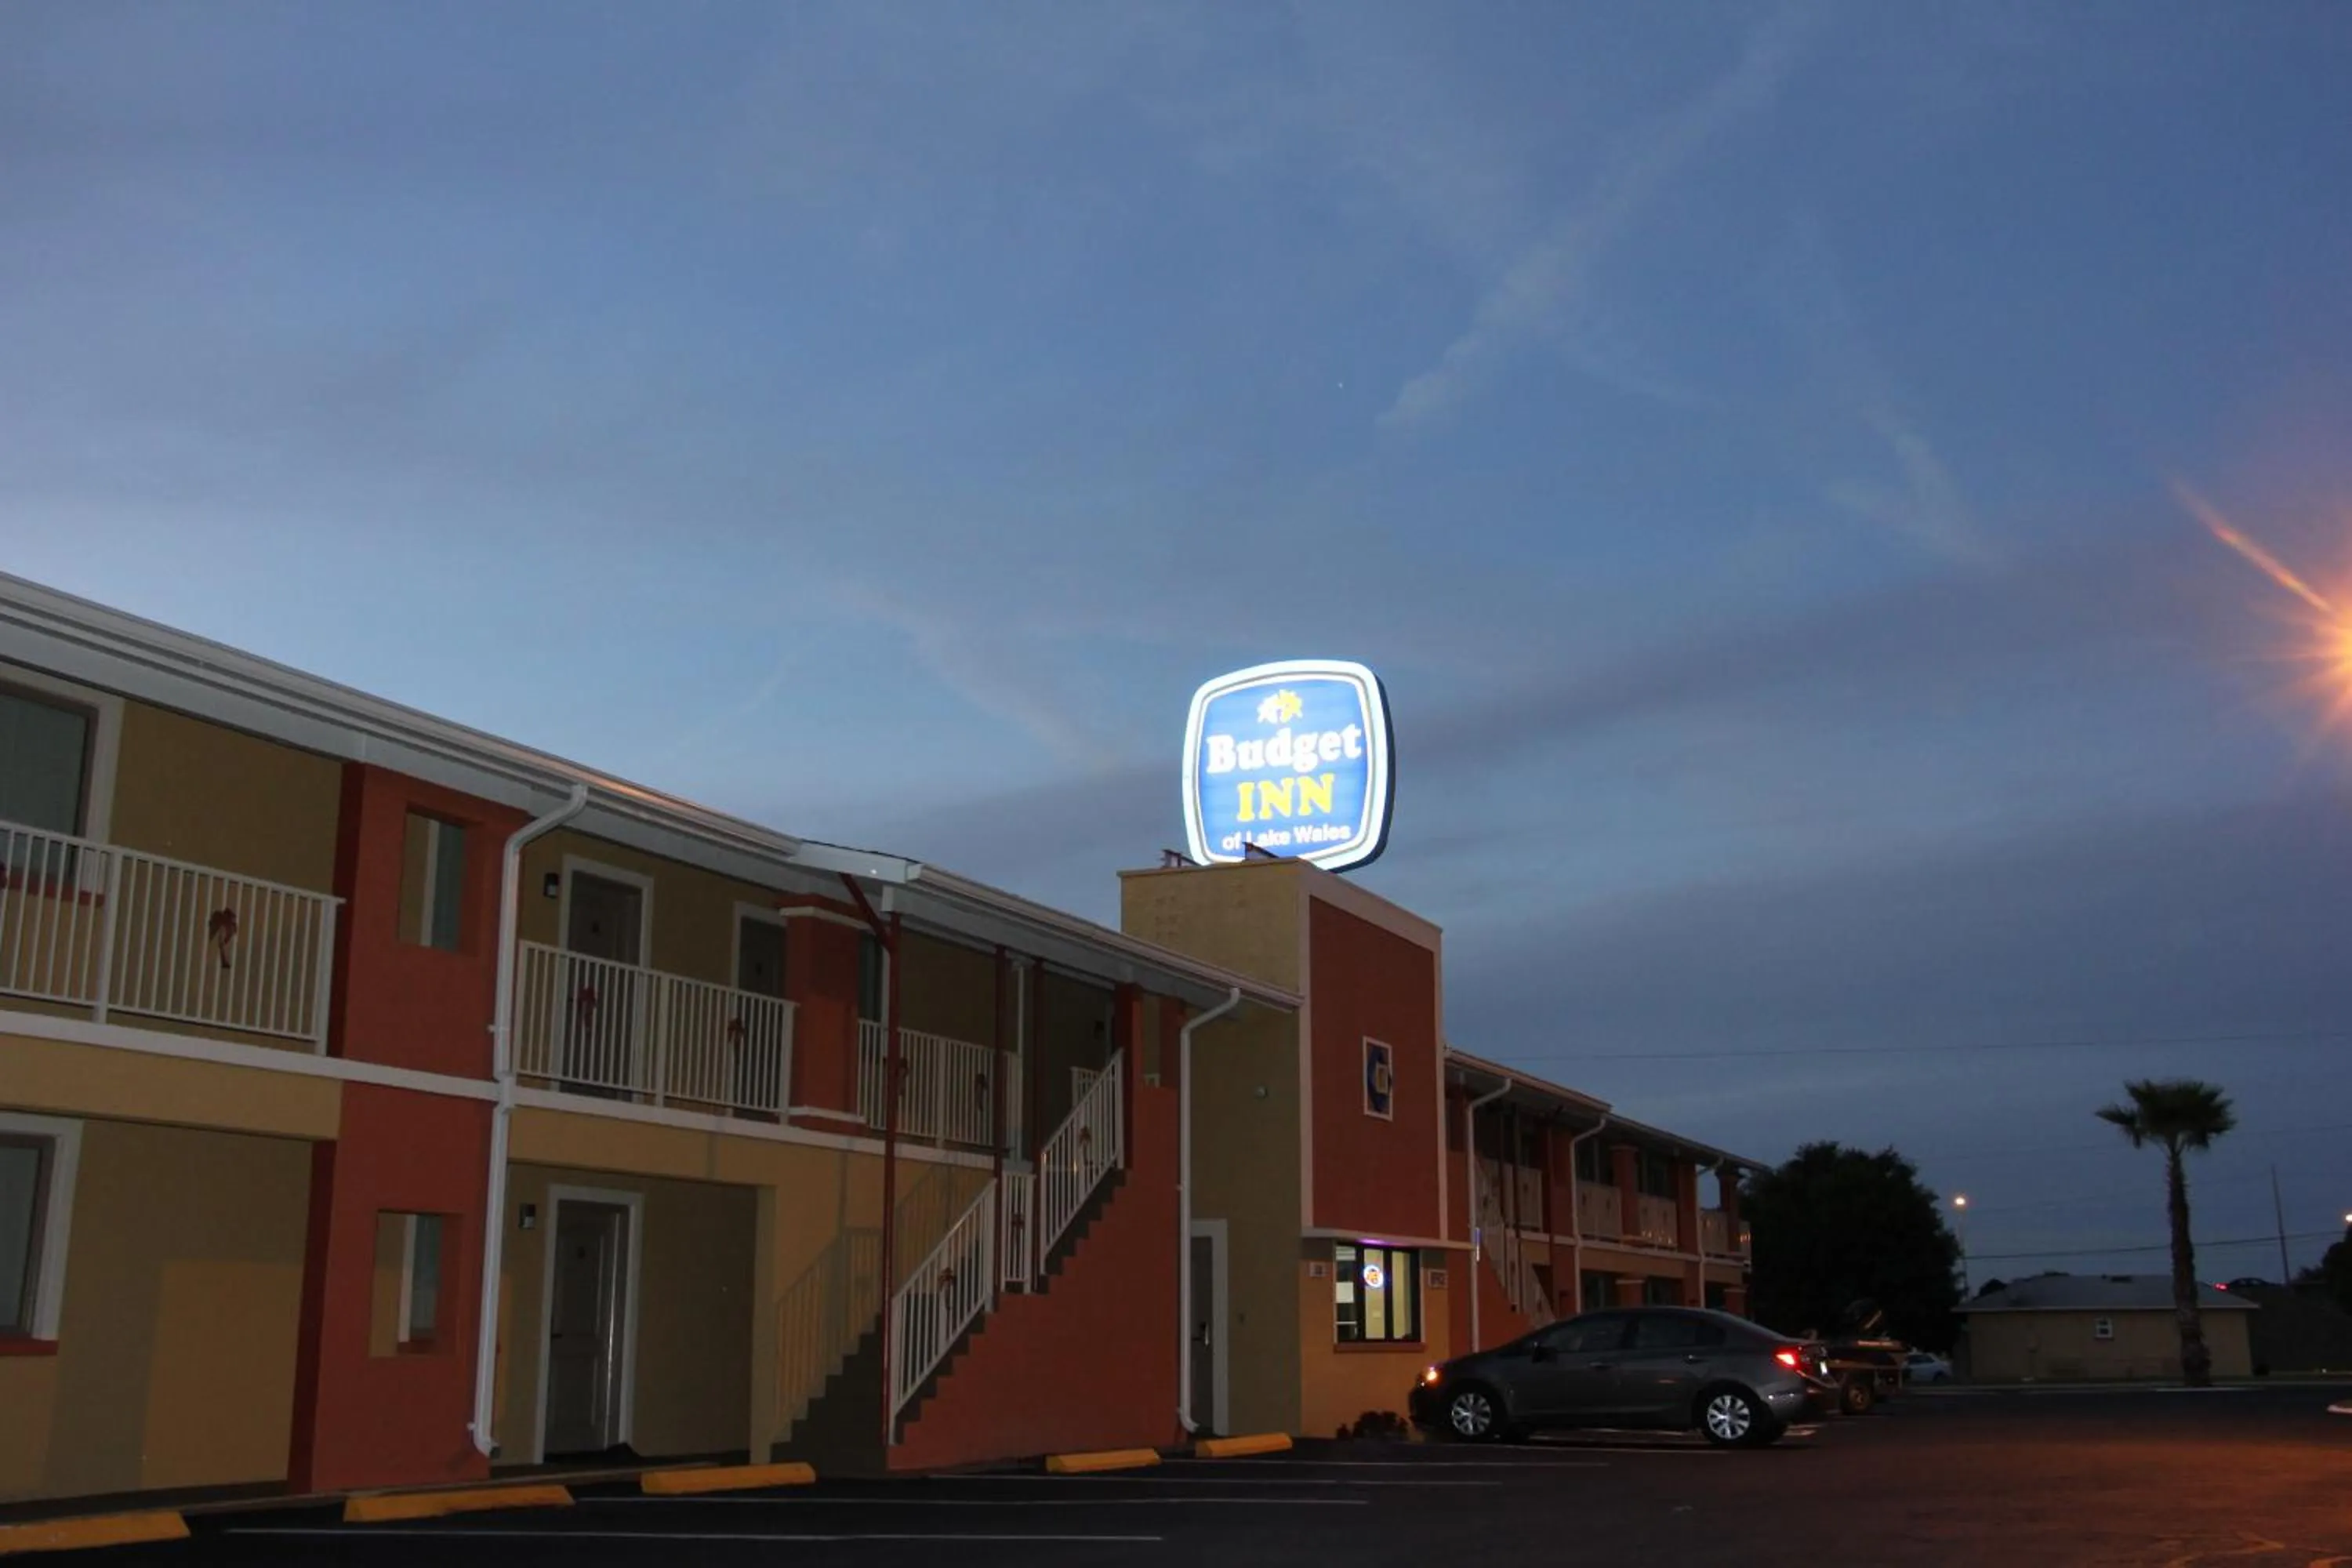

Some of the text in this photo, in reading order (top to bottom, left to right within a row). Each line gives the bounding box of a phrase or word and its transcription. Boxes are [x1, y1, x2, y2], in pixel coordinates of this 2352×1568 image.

[1207, 724, 1362, 773] Budget
[1237, 773, 1334, 822] INN
[1222, 831, 1241, 850] of
[1294, 824, 1351, 843] Wales
